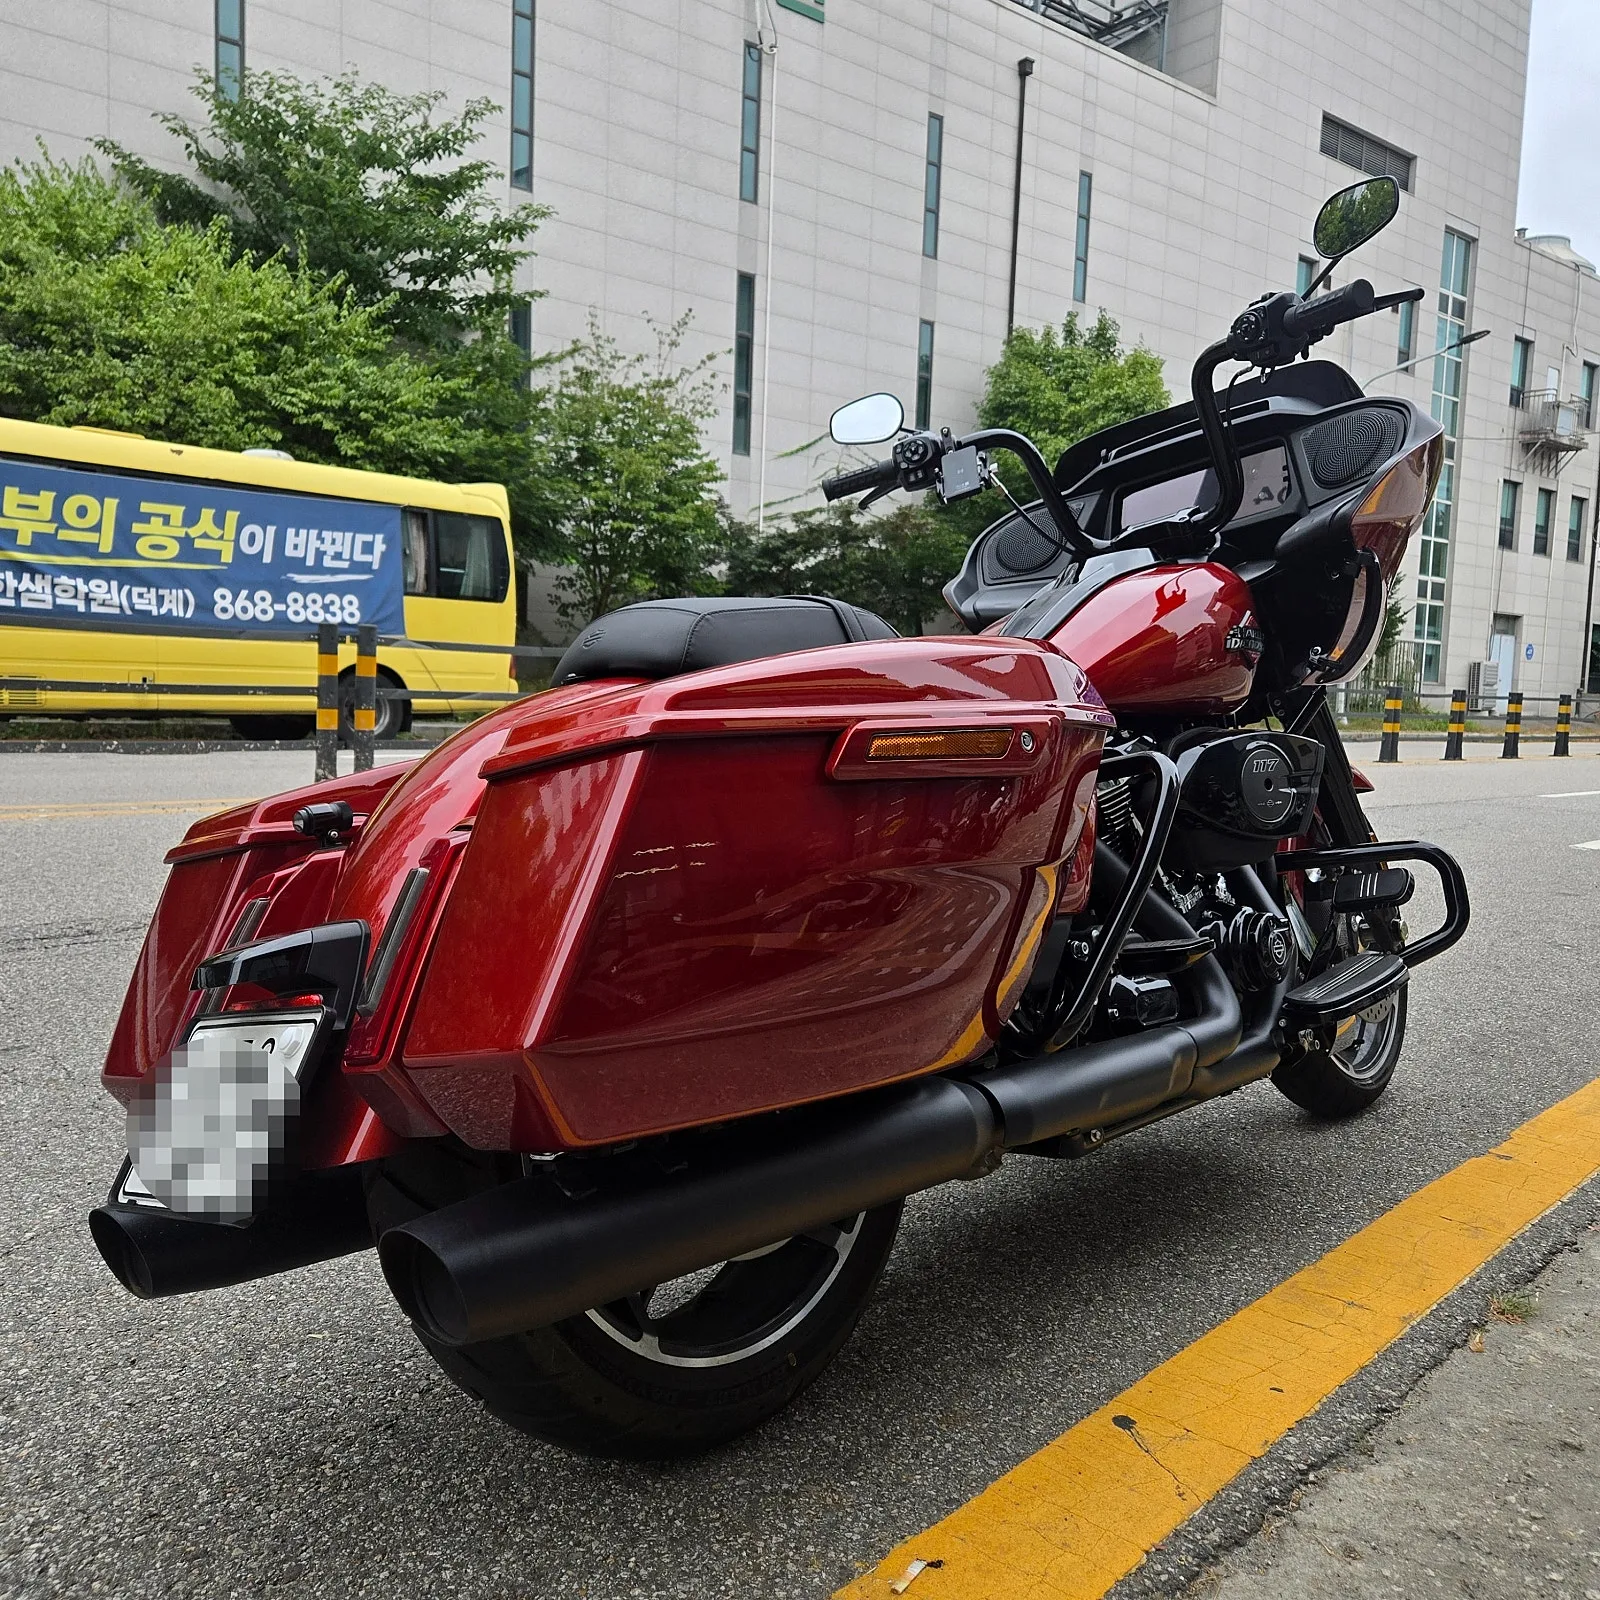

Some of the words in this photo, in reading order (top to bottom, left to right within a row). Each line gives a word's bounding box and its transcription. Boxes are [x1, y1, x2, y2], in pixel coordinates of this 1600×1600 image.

[131, 502, 276, 563] 공식이
[285, 528, 386, 570] 바뀐다
[213, 587, 361, 624] 868-8838
[1253, 758, 1279, 773] 117
